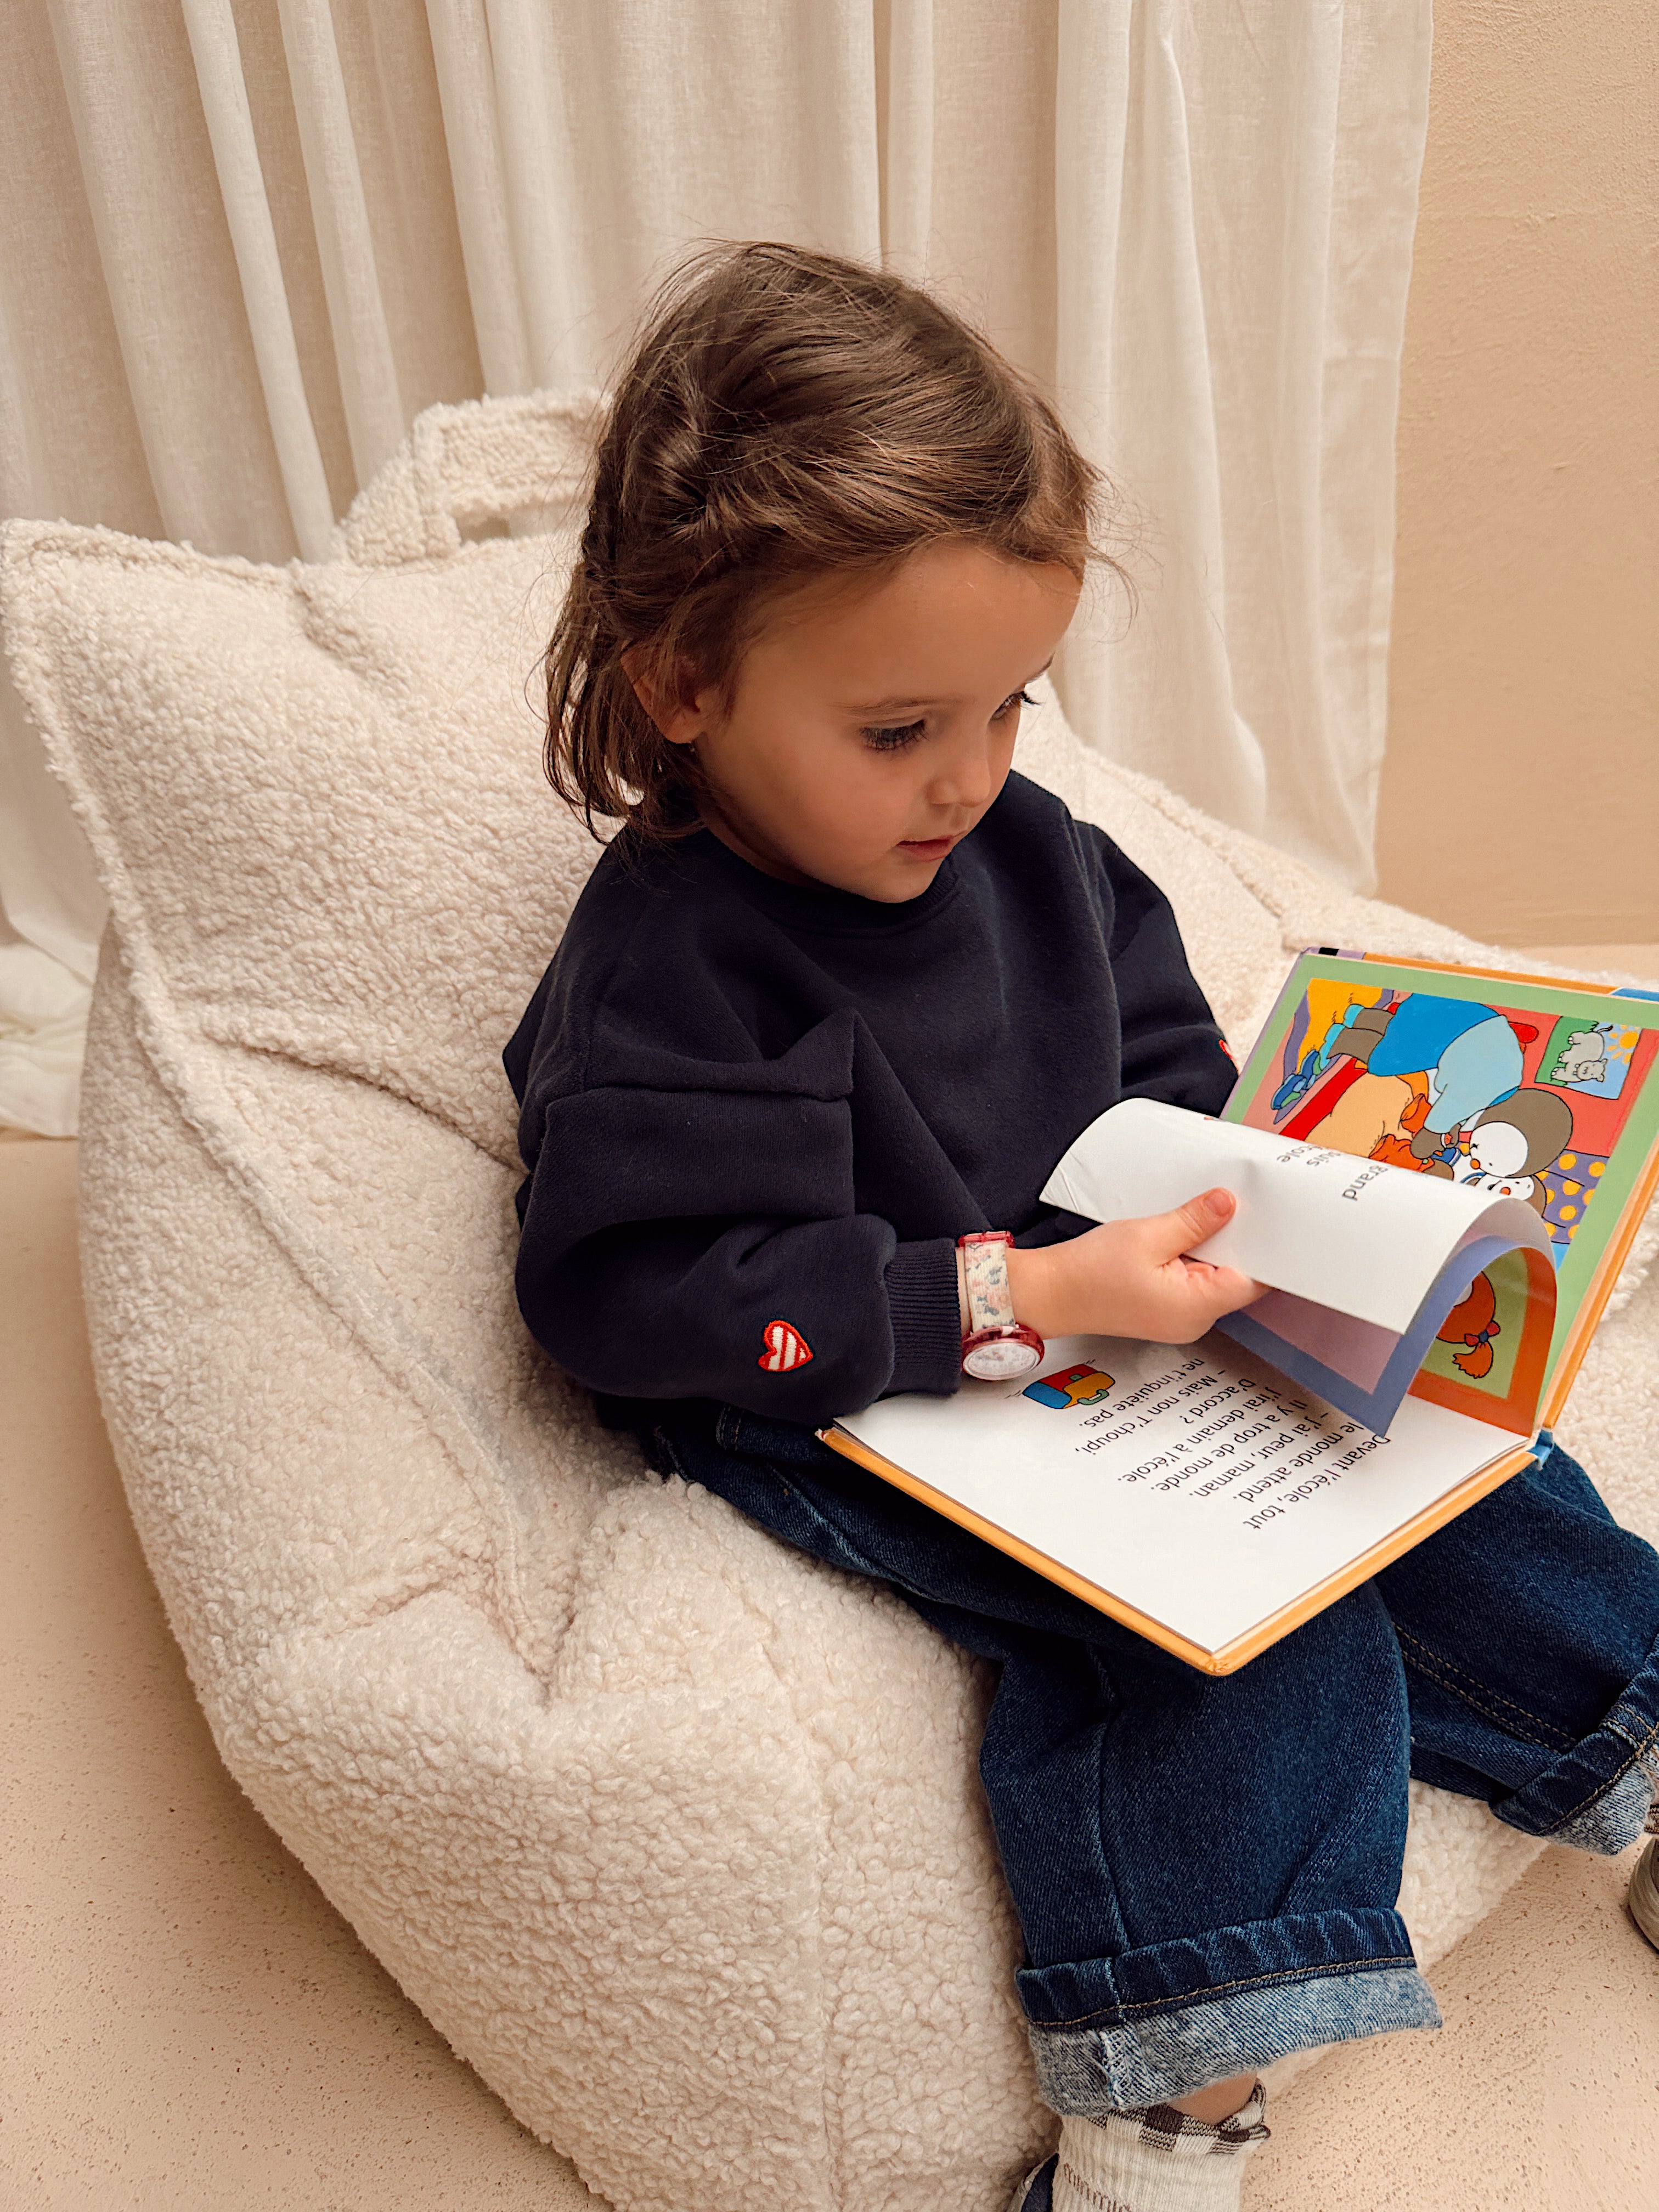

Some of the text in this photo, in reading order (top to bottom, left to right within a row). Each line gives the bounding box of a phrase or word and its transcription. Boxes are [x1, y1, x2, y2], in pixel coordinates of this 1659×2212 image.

[1342, 1165, 1389, 1201] grand
[1079, 1358, 1205, 1427] ne t'inquiète pas.
[1178, 1375, 1218, 1397] Mais
[1189, 1378, 1256, 1418] D'accord
[1147, 1396, 1181, 1415] non
[1277, 1406, 1294, 1416] y
[1289, 1400, 1308, 1410] Il
[1075, 1415, 1153, 1455] T'choupi,
[1118, 1386, 1282, 1482] J'irai demain à l'école.
[1234, 1423, 1272, 1443] trop
[1291, 1416, 1322, 1437] J'ai
[1211, 1443, 1235, 1457] de
[1233, 1421, 1364, 1503] le monde attend.
[1250, 1432, 1295, 1460] peur,
[1150, 1457, 1214, 1491] monde.
[1189, 1459, 1255, 1497] maman.
[1243, 1435, 1391, 1530] Devant l'école, tout
